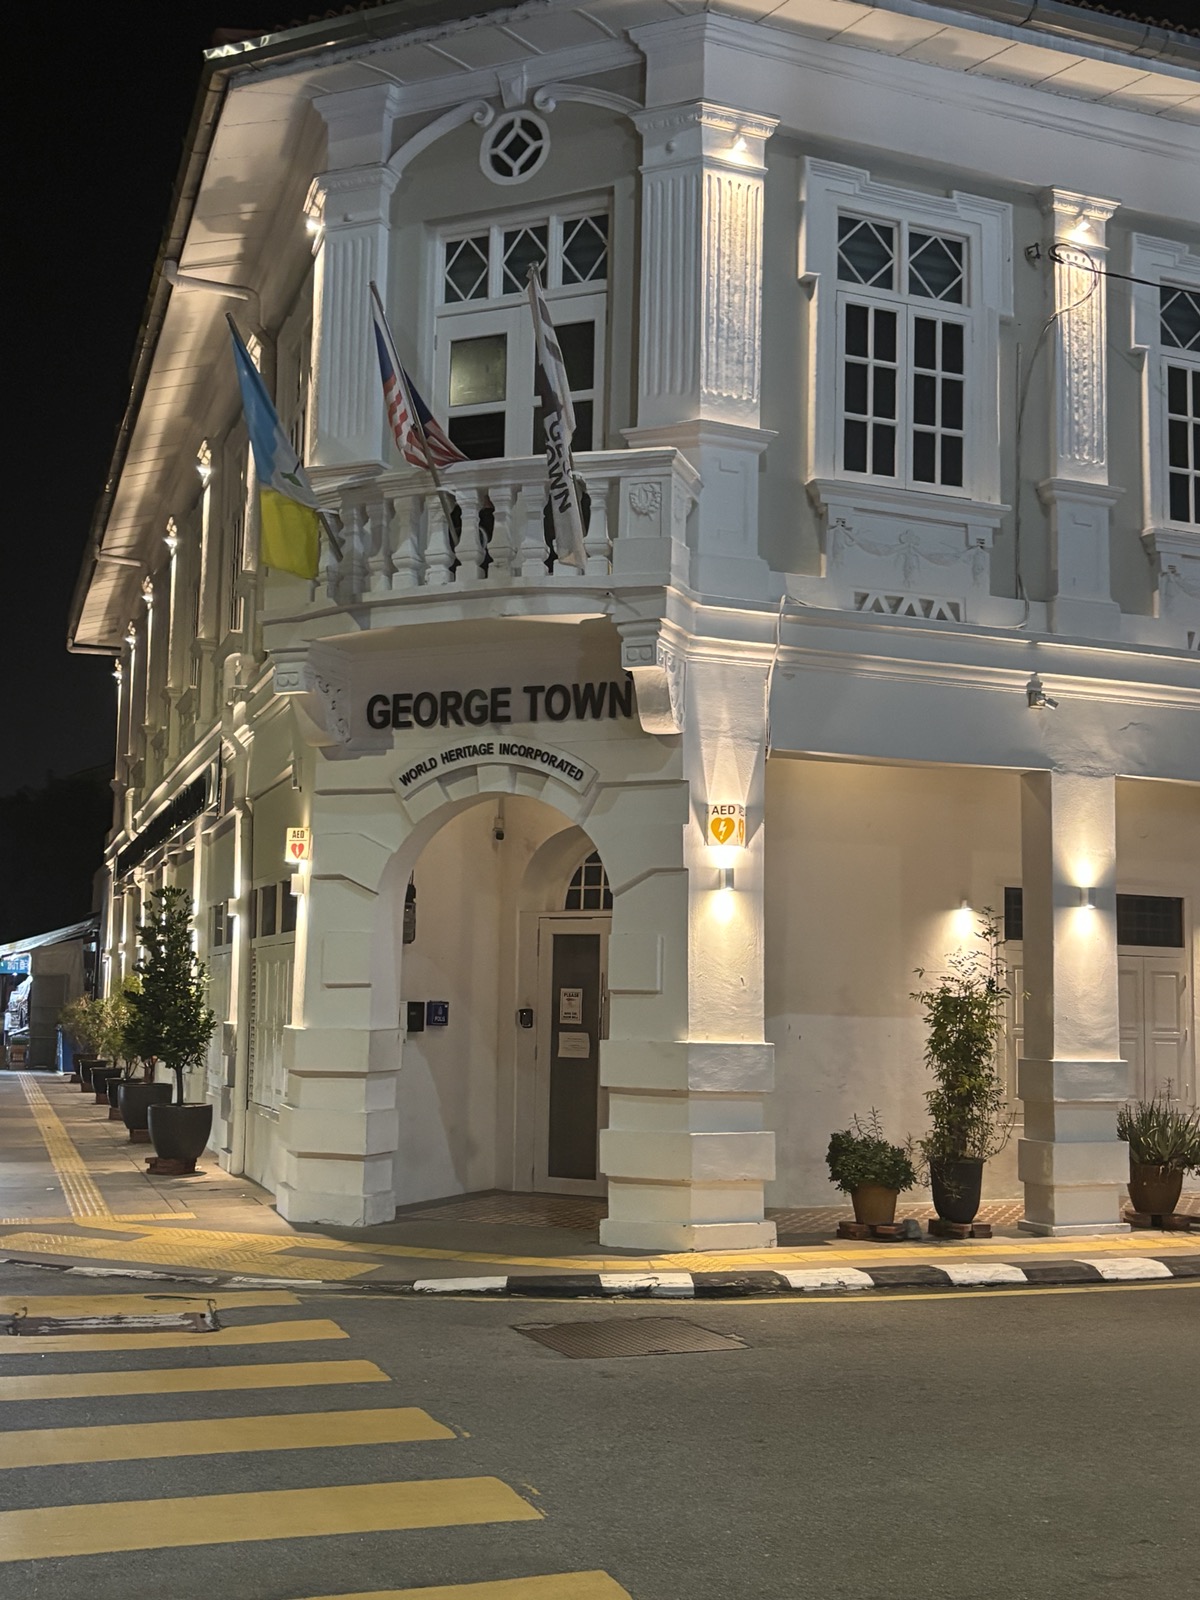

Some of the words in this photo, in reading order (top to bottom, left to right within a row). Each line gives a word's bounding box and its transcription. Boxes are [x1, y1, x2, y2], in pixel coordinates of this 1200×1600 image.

[366, 687, 512, 730] GEORGE
[523, 680, 632, 722] TOWN
[398, 757, 438, 787] WORLD
[440, 742, 494, 765] HERITAGE
[499, 742, 584, 782] INCORPORATED
[711, 805, 736, 815] AED
[292, 830, 305, 839] AED
